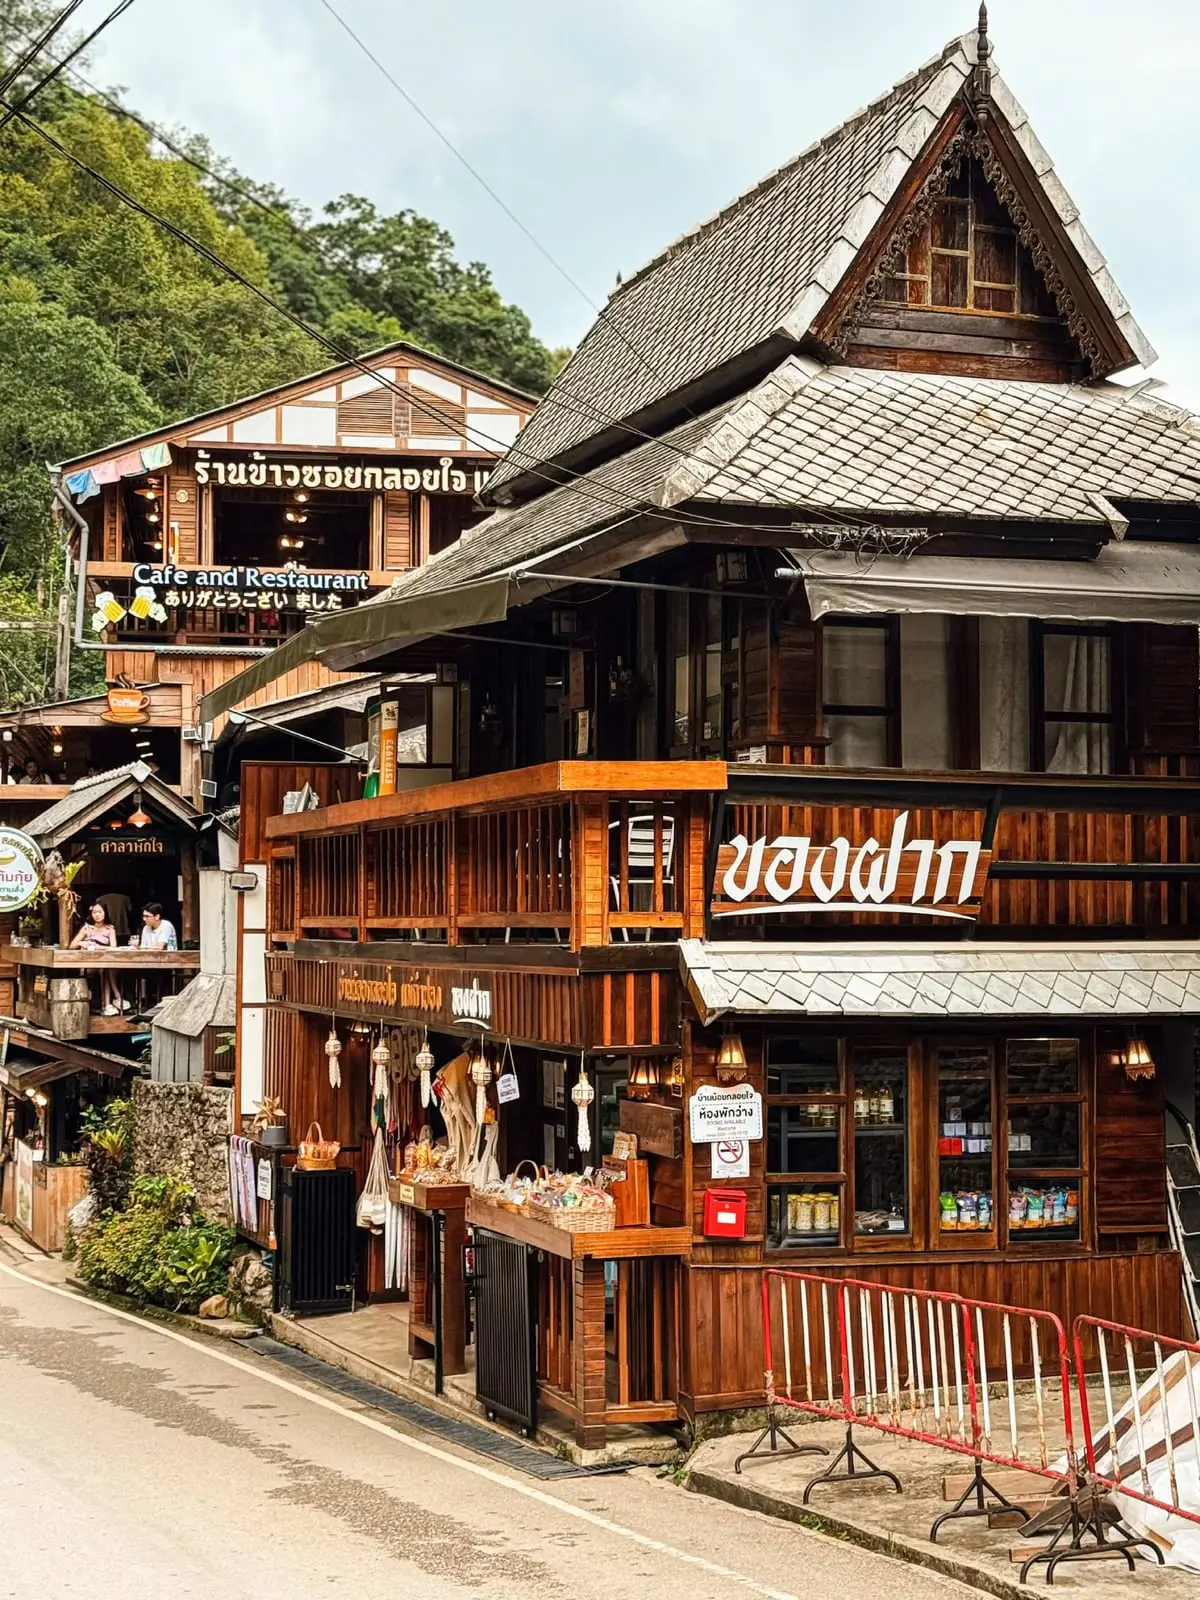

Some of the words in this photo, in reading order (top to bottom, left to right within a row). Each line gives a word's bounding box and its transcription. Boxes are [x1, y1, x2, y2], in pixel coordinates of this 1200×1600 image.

[195, 449, 467, 492] ร้านข้าวซอยกลอยใจ
[133, 564, 188, 585] Cafe
[196, 567, 238, 587] and
[245, 568, 369, 590] Restaurant
[165, 590, 289, 609] ありがとうござい
[296, 592, 342, 610] ました
[385, 739, 394, 761] 1933
[722, 810, 982, 905] ของฝาก
[451, 978, 492, 1020] ของฝาก
[699, 1105, 753, 1119] ห้องพักว่าง
